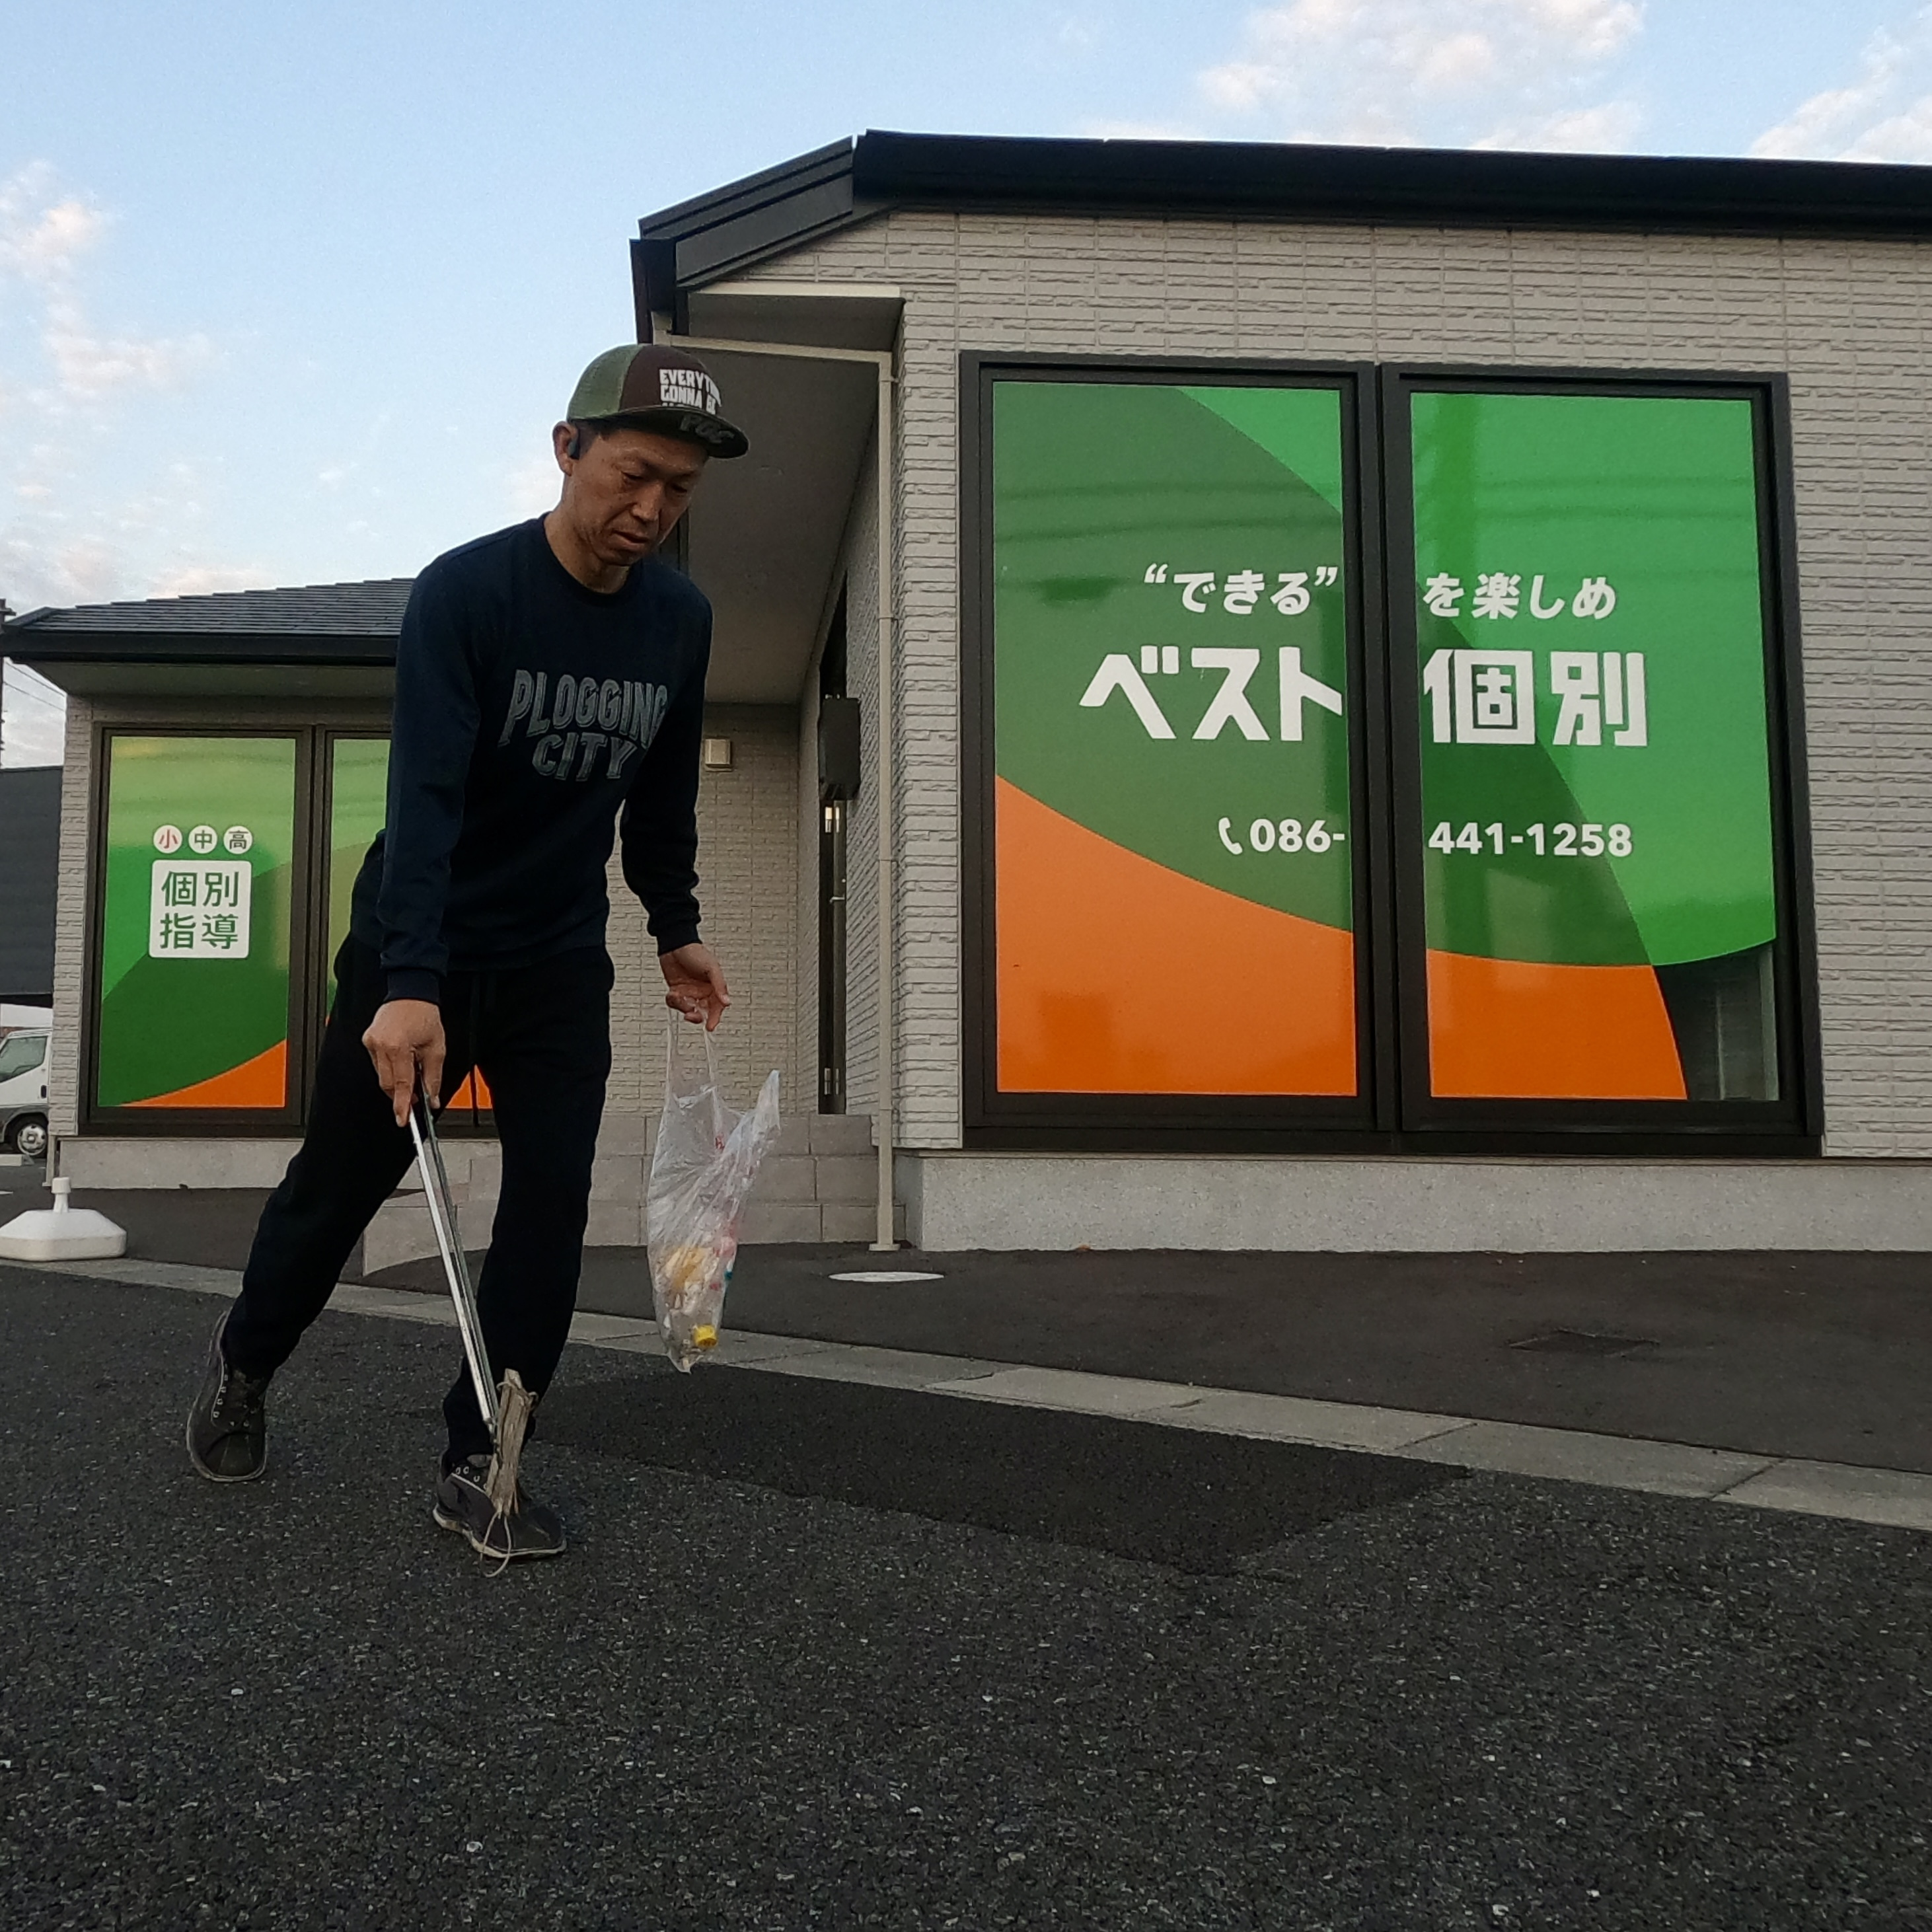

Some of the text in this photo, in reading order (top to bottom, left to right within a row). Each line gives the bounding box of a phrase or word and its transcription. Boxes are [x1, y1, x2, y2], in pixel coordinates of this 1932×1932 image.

[661, 385, 703, 409] GONNA
[1423, 572, 1616, 620] を楽しめ
[498, 669, 667, 749] PLOGGING
[1079, 645, 1647, 747] ベスト 個別
[531, 731, 638, 782] CITY
[1429, 822, 1632, 857] 441-1258
[161, 870, 240, 907] 個別
[159, 912, 239, 949] 指導
